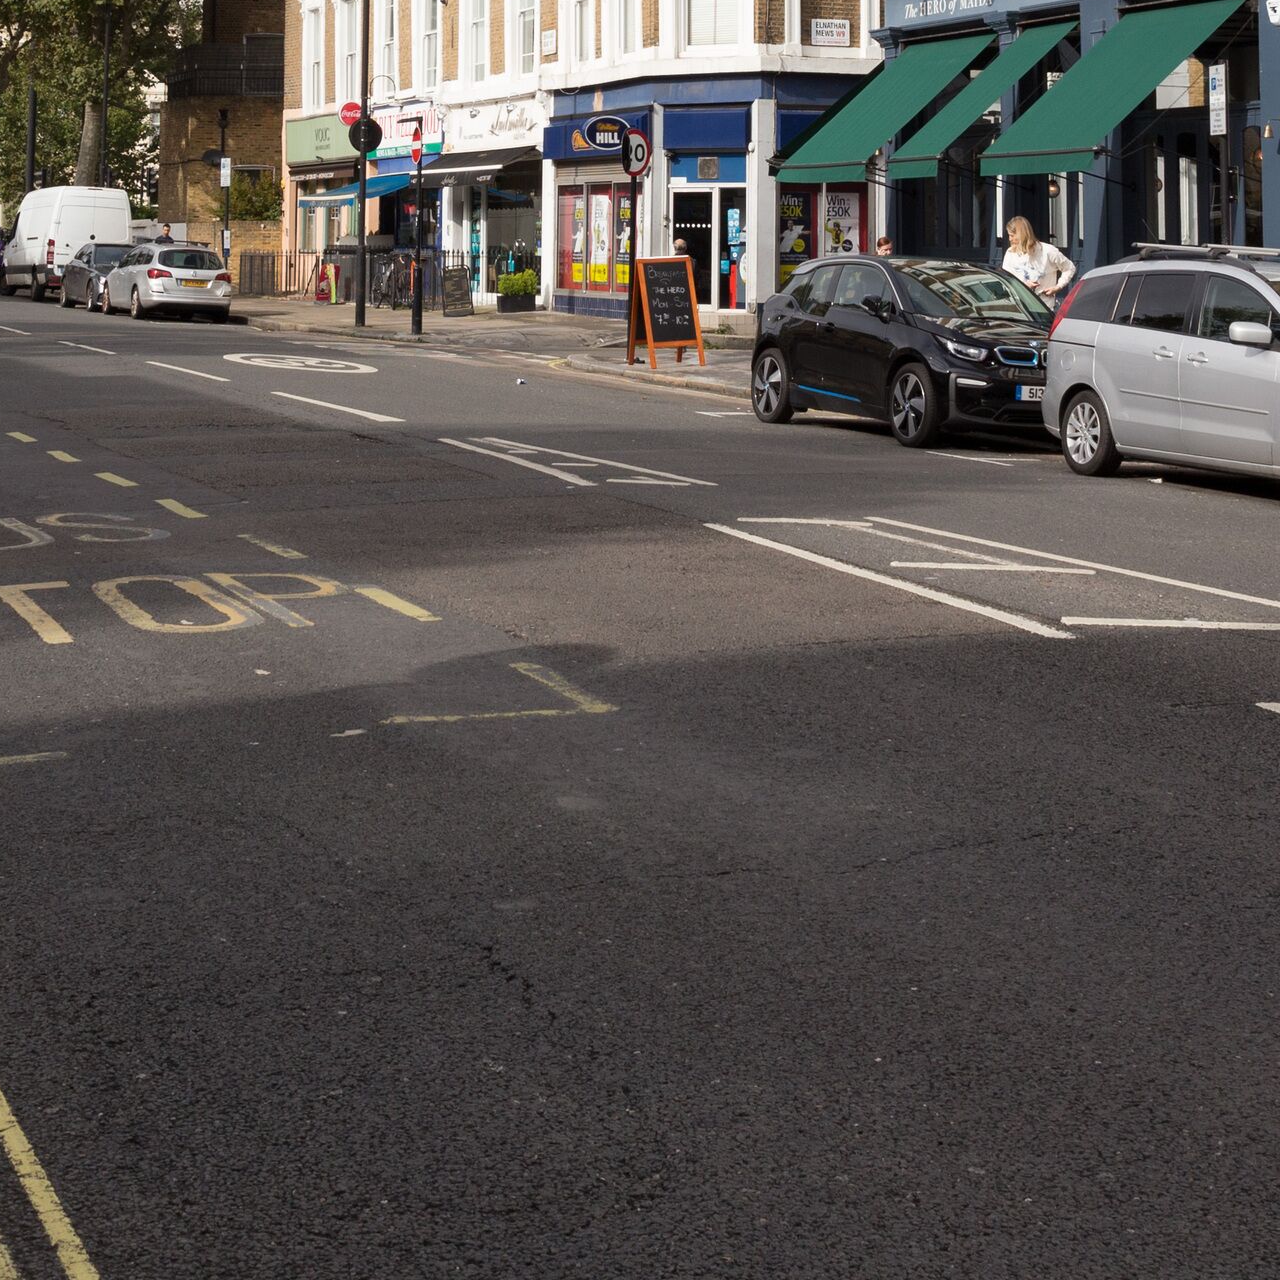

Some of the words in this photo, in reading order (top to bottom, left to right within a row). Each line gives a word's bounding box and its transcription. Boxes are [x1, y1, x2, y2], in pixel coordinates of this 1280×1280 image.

[904, 3, 918, 19] The
[815, 21, 846, 29] ELNATHAN
[596, 132, 620, 144] HILL
[780, 194, 798, 205] Win
[826, 195, 846, 206] Win
[826, 207, 851, 217] £50K
[666, 286, 686, 294] HERO
